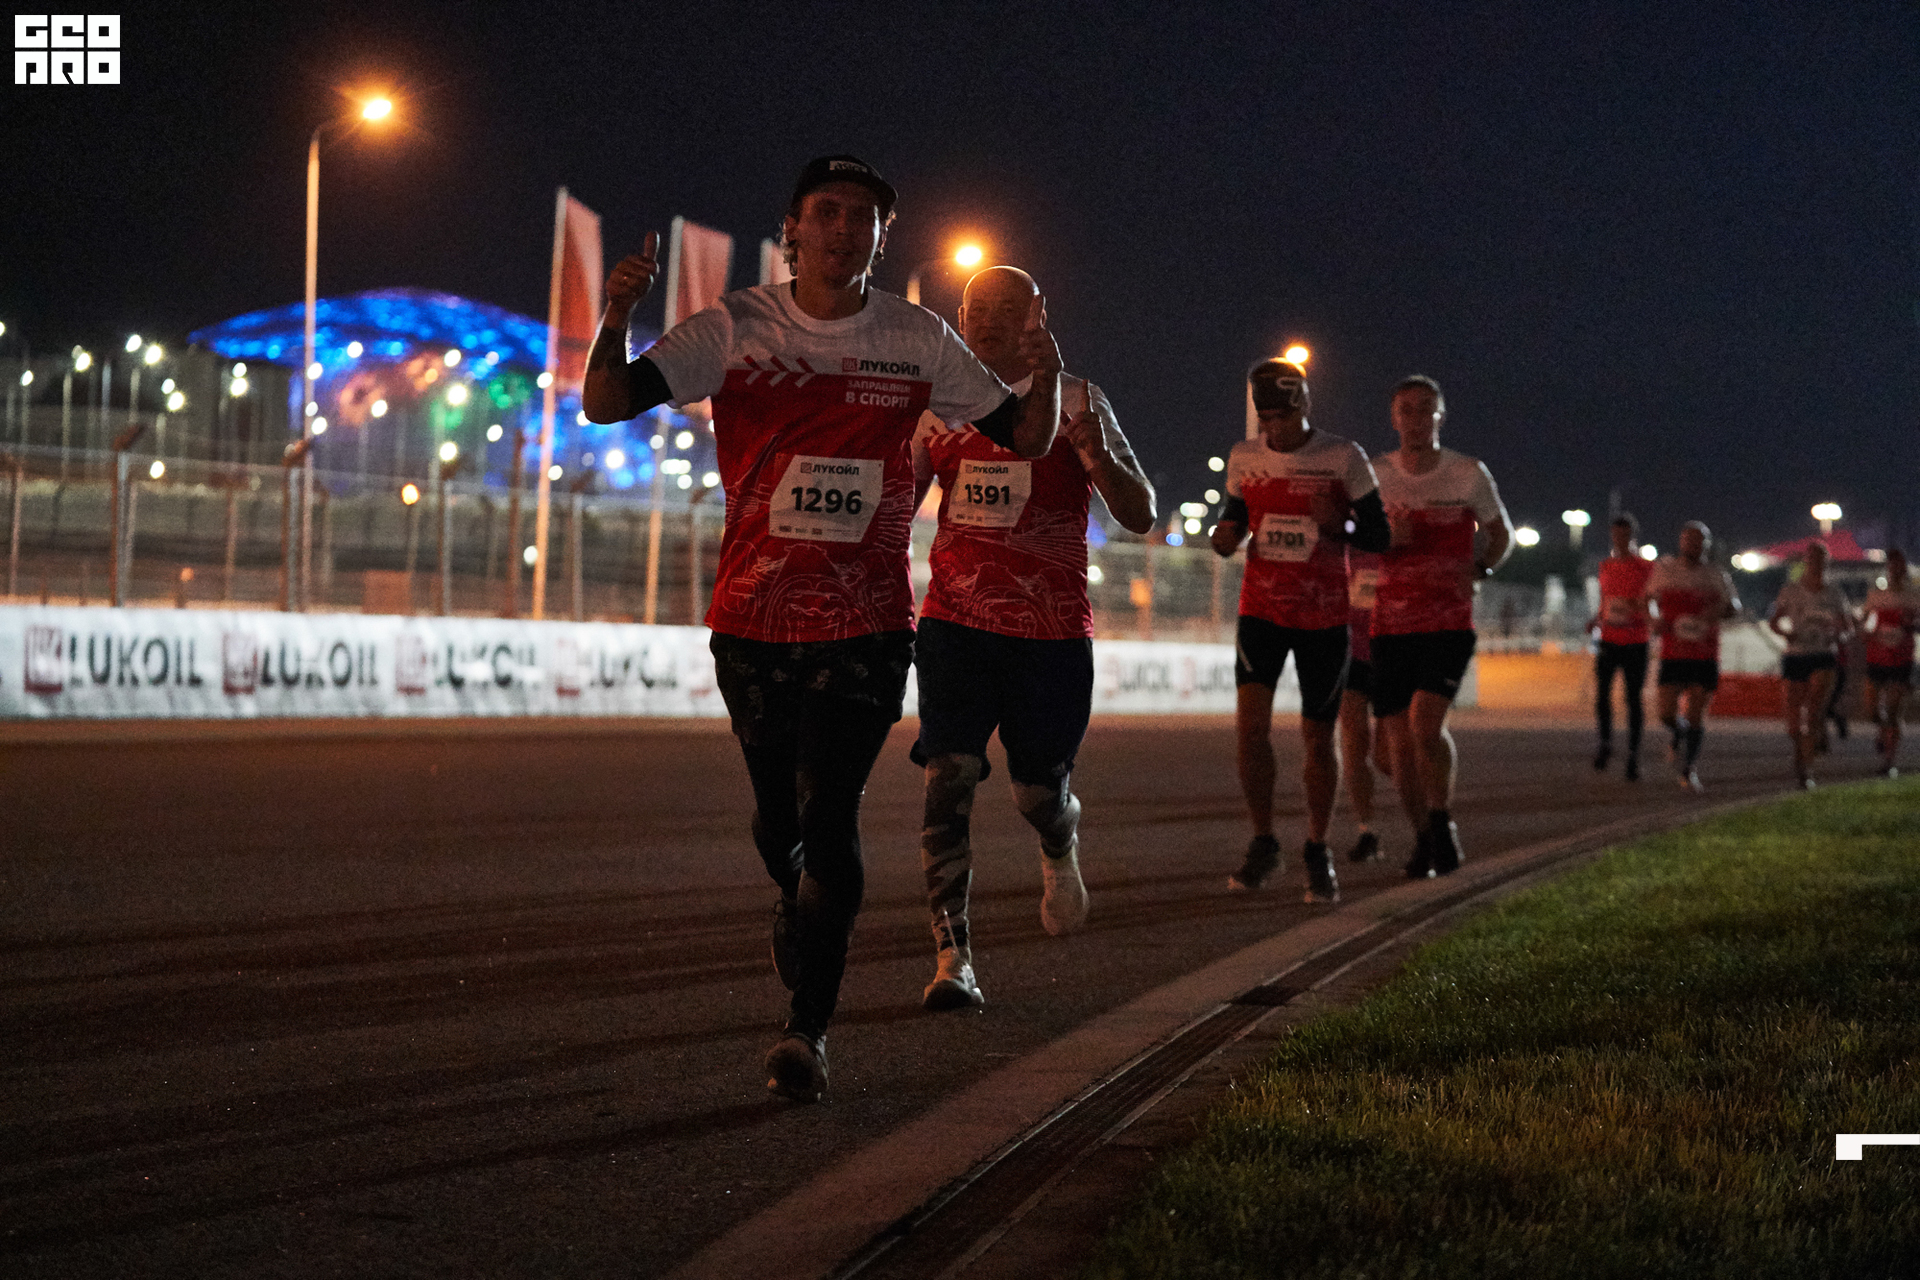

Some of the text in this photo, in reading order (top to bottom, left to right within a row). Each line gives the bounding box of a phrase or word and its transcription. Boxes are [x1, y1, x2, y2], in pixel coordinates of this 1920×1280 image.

[859, 360, 920, 377] ЛУКОЙЛ
[845, 391, 855, 405] В
[811, 464, 860, 475] ЛУКОЙЛ
[972, 465, 1009, 474] ЛУКОЙЛ
[791, 486, 862, 515] 1296
[964, 484, 1010, 505] 1391
[70, 636, 203, 687] LUKOIL
